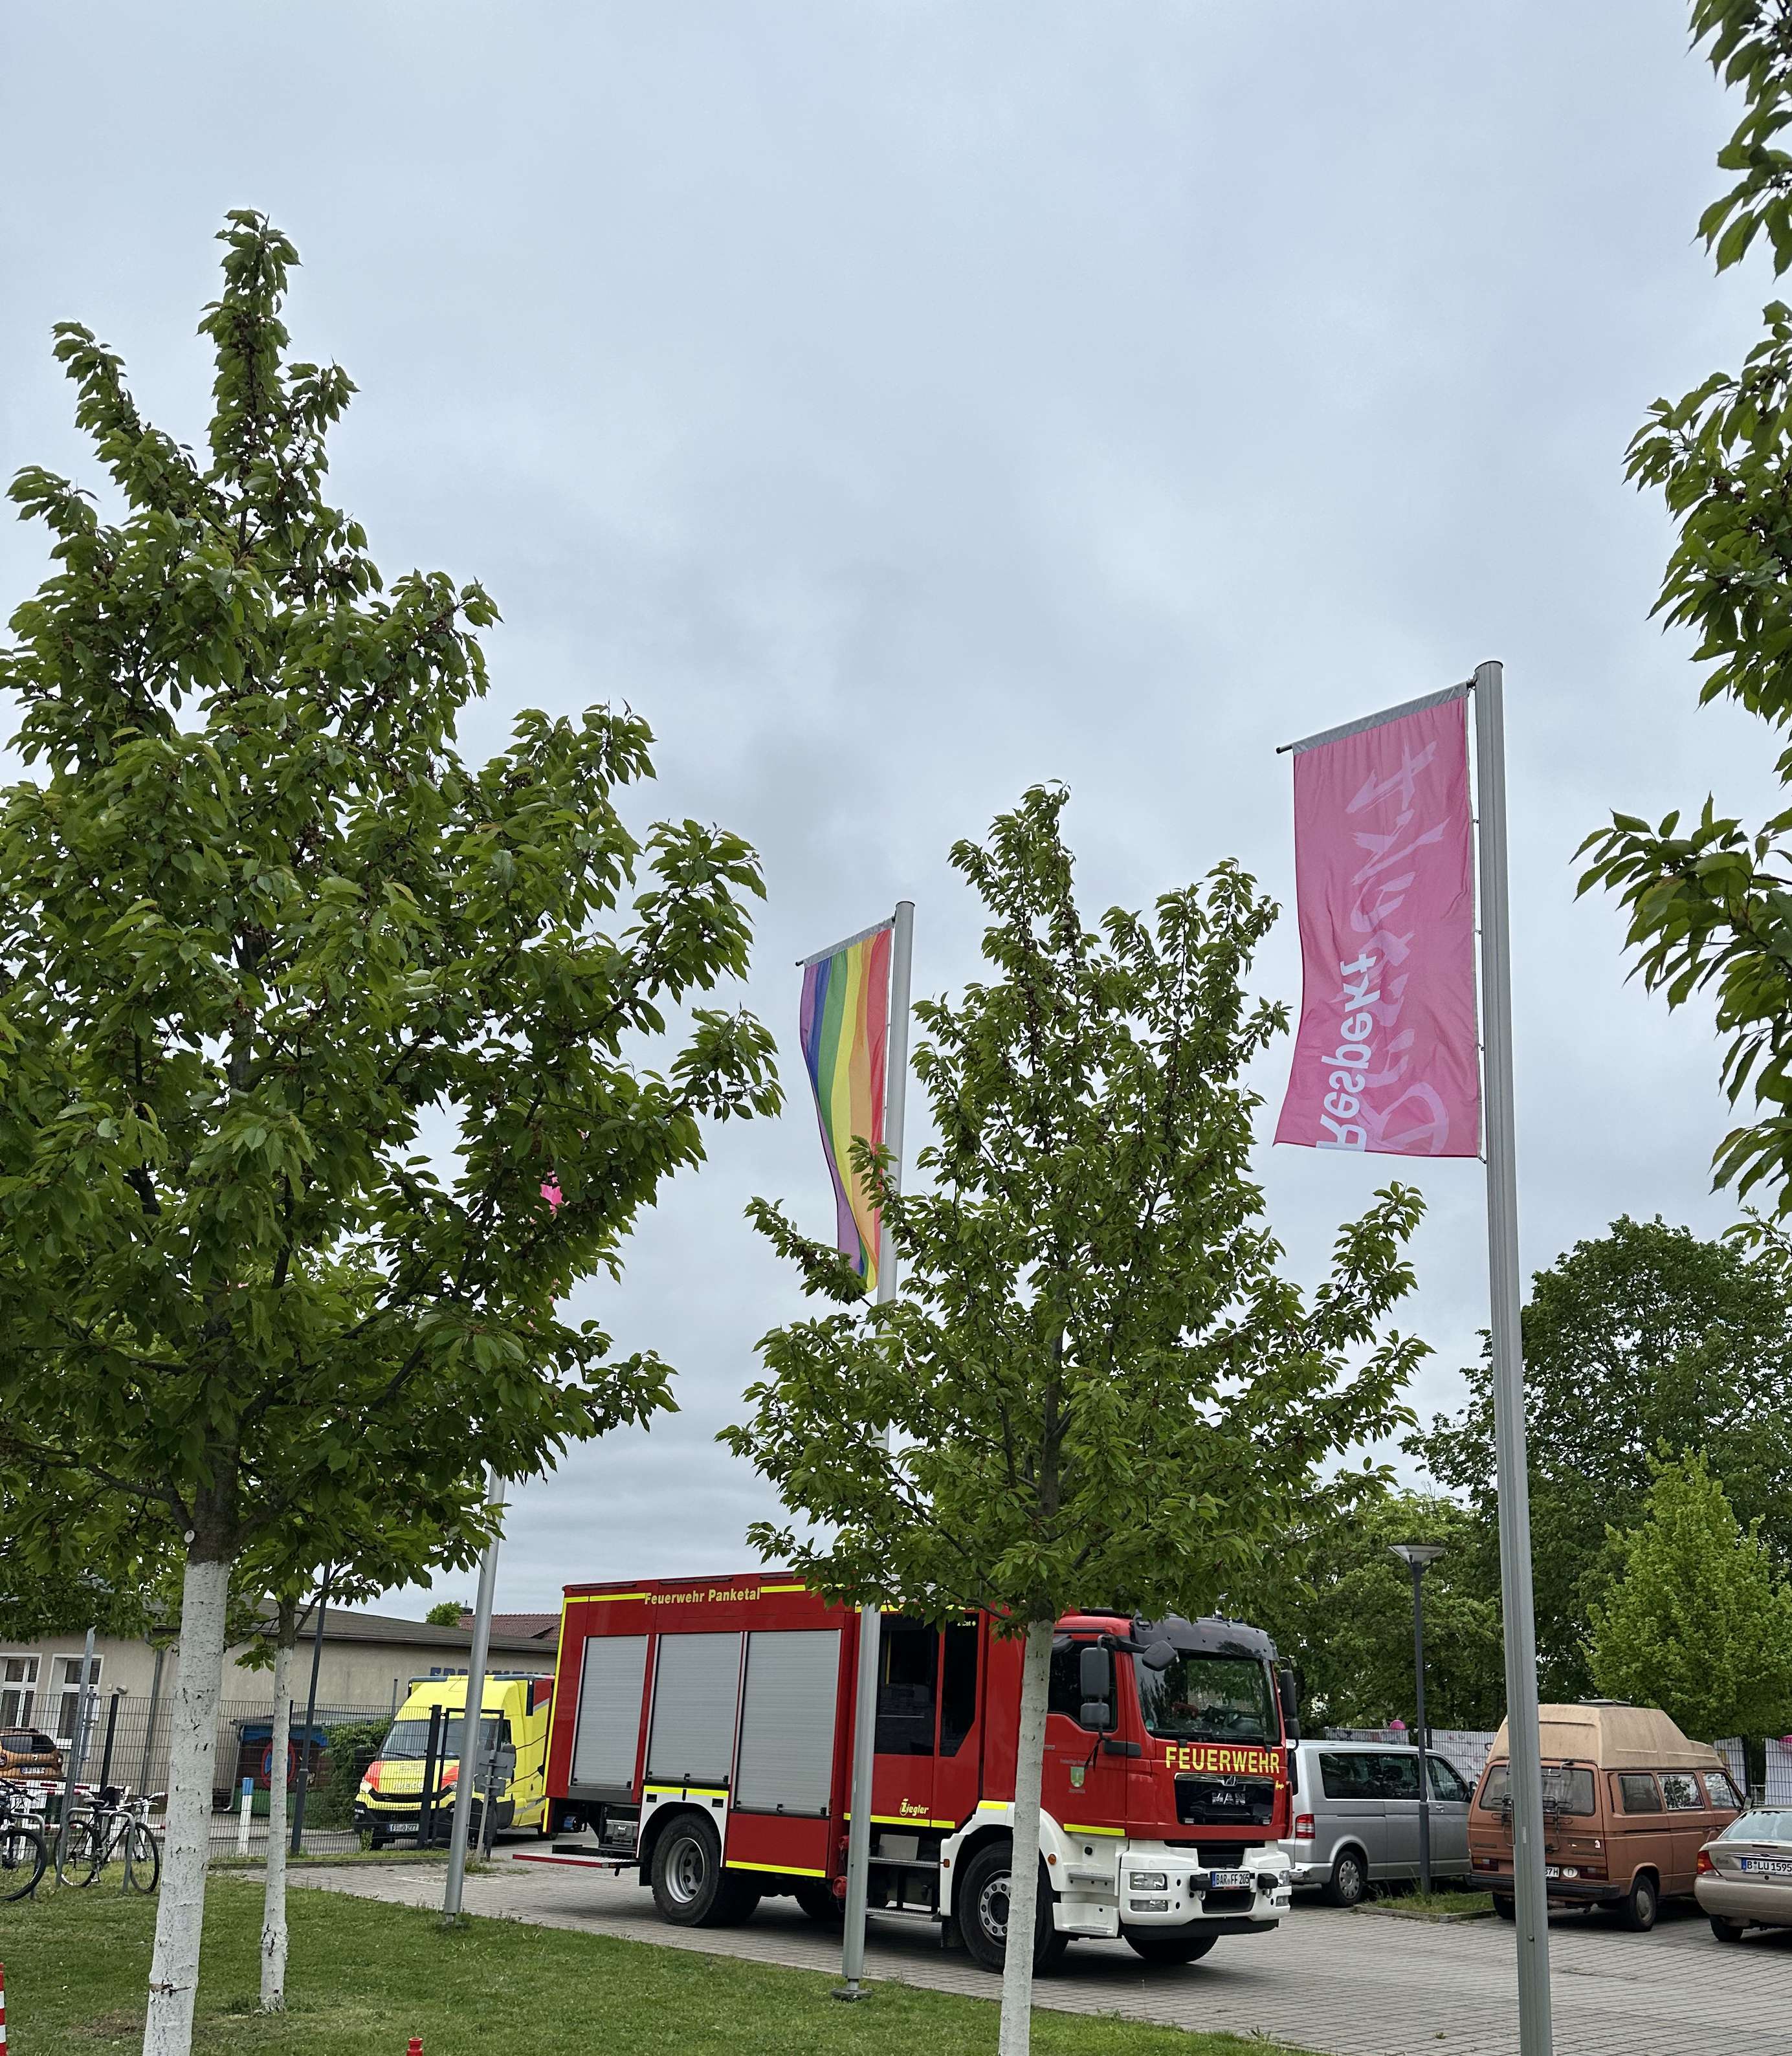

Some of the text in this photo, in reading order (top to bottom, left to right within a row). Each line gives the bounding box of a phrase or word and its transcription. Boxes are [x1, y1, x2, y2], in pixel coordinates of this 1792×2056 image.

[645, 1587, 760, 1605] Feuerwehr Panketal
[1166, 1747, 1280, 1774] FEUERWEHR
[900, 1798, 929, 1817] Ziegler
[1747, 1861, 1792, 1872] B LU 1595
[1217, 1874, 1227, 1885] BAR
[1231, 1874, 1239, 1885] FF
